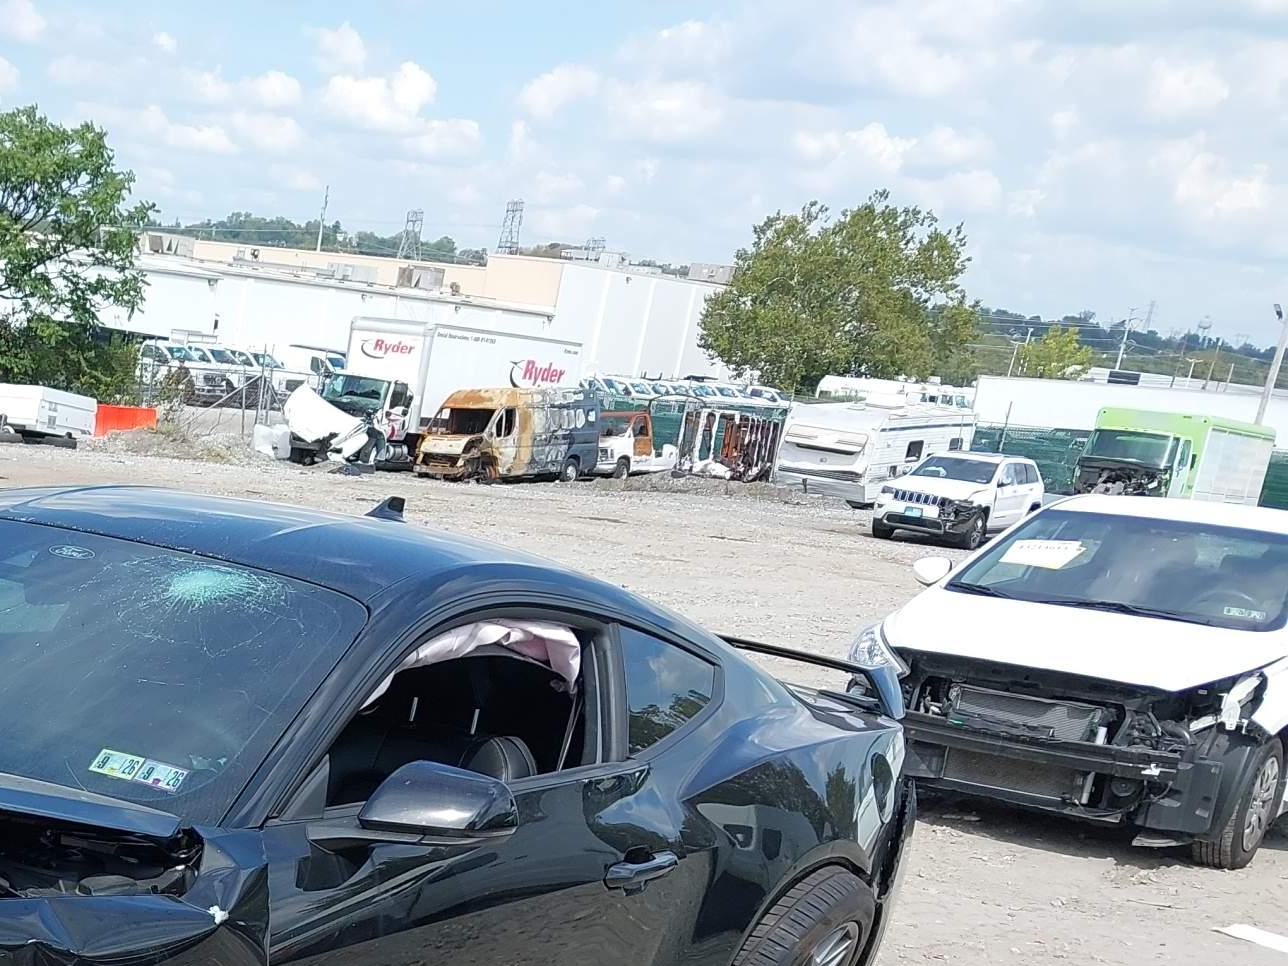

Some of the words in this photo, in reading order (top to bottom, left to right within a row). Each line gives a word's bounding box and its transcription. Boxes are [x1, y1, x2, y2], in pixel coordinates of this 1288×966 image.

[373, 338, 415, 356] Ryder
[523, 360, 566, 385] Ryder
[122, 758, 139, 775] 26
[166, 771, 184, 787] 26
